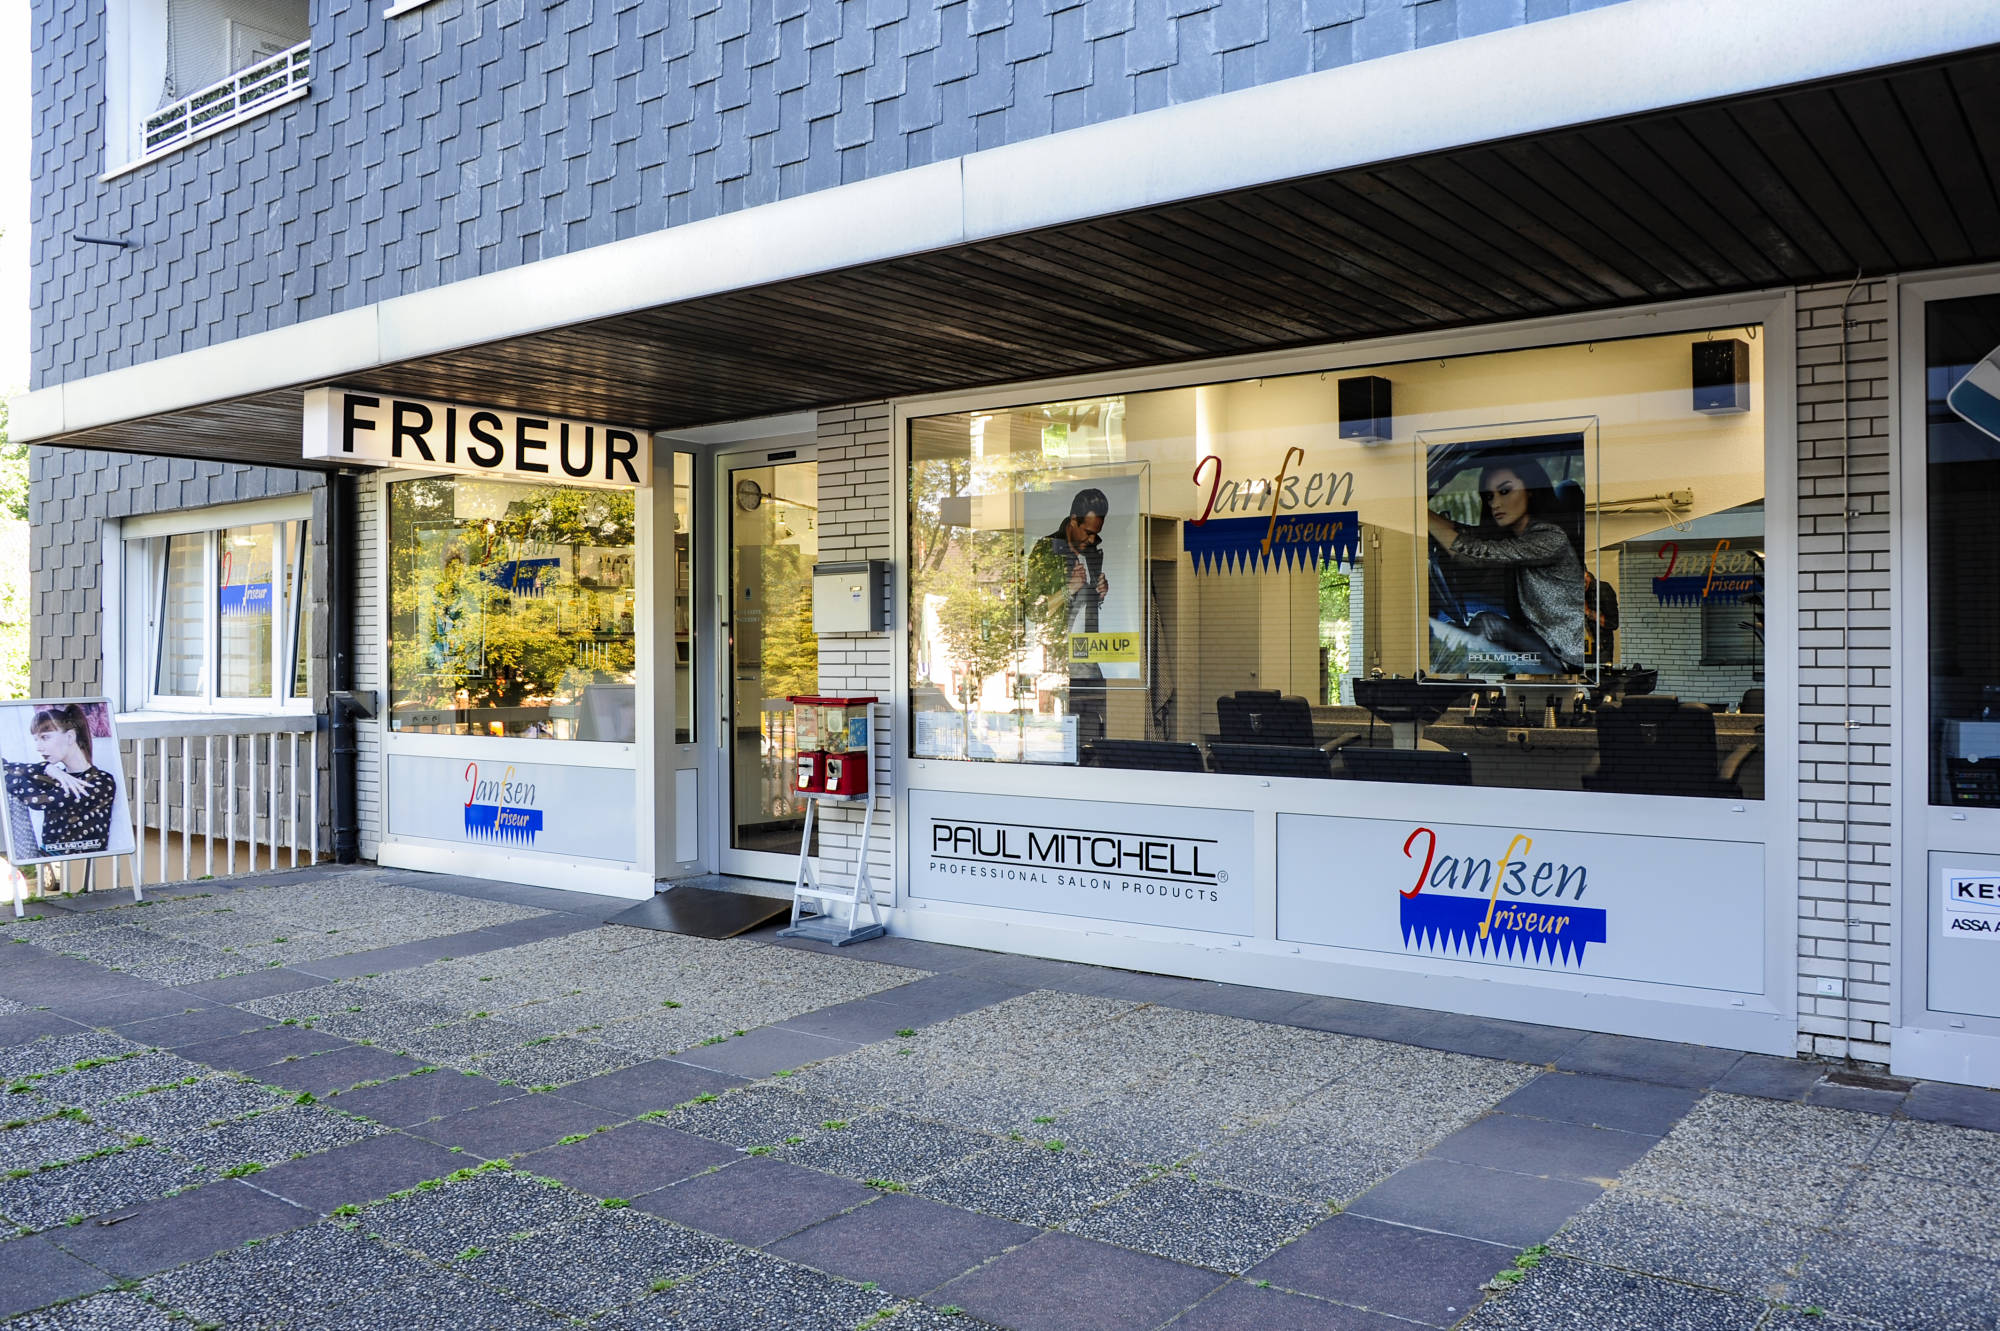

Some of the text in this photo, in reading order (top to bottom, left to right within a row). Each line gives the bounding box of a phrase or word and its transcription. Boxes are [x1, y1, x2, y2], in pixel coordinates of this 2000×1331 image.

[343, 393, 640, 482] FRISEUR
[1112, 639, 1130, 652] UP
[1468, 653, 1541, 662] PAUL MITCHELL
[932, 824, 1021, 860] PAUL
[929, 862, 1218, 903] PROFESSIONAL SALON PRODUCTS
[1958, 882, 2000, 899] KE
[1951, 918, 1992, 932] ASSA
